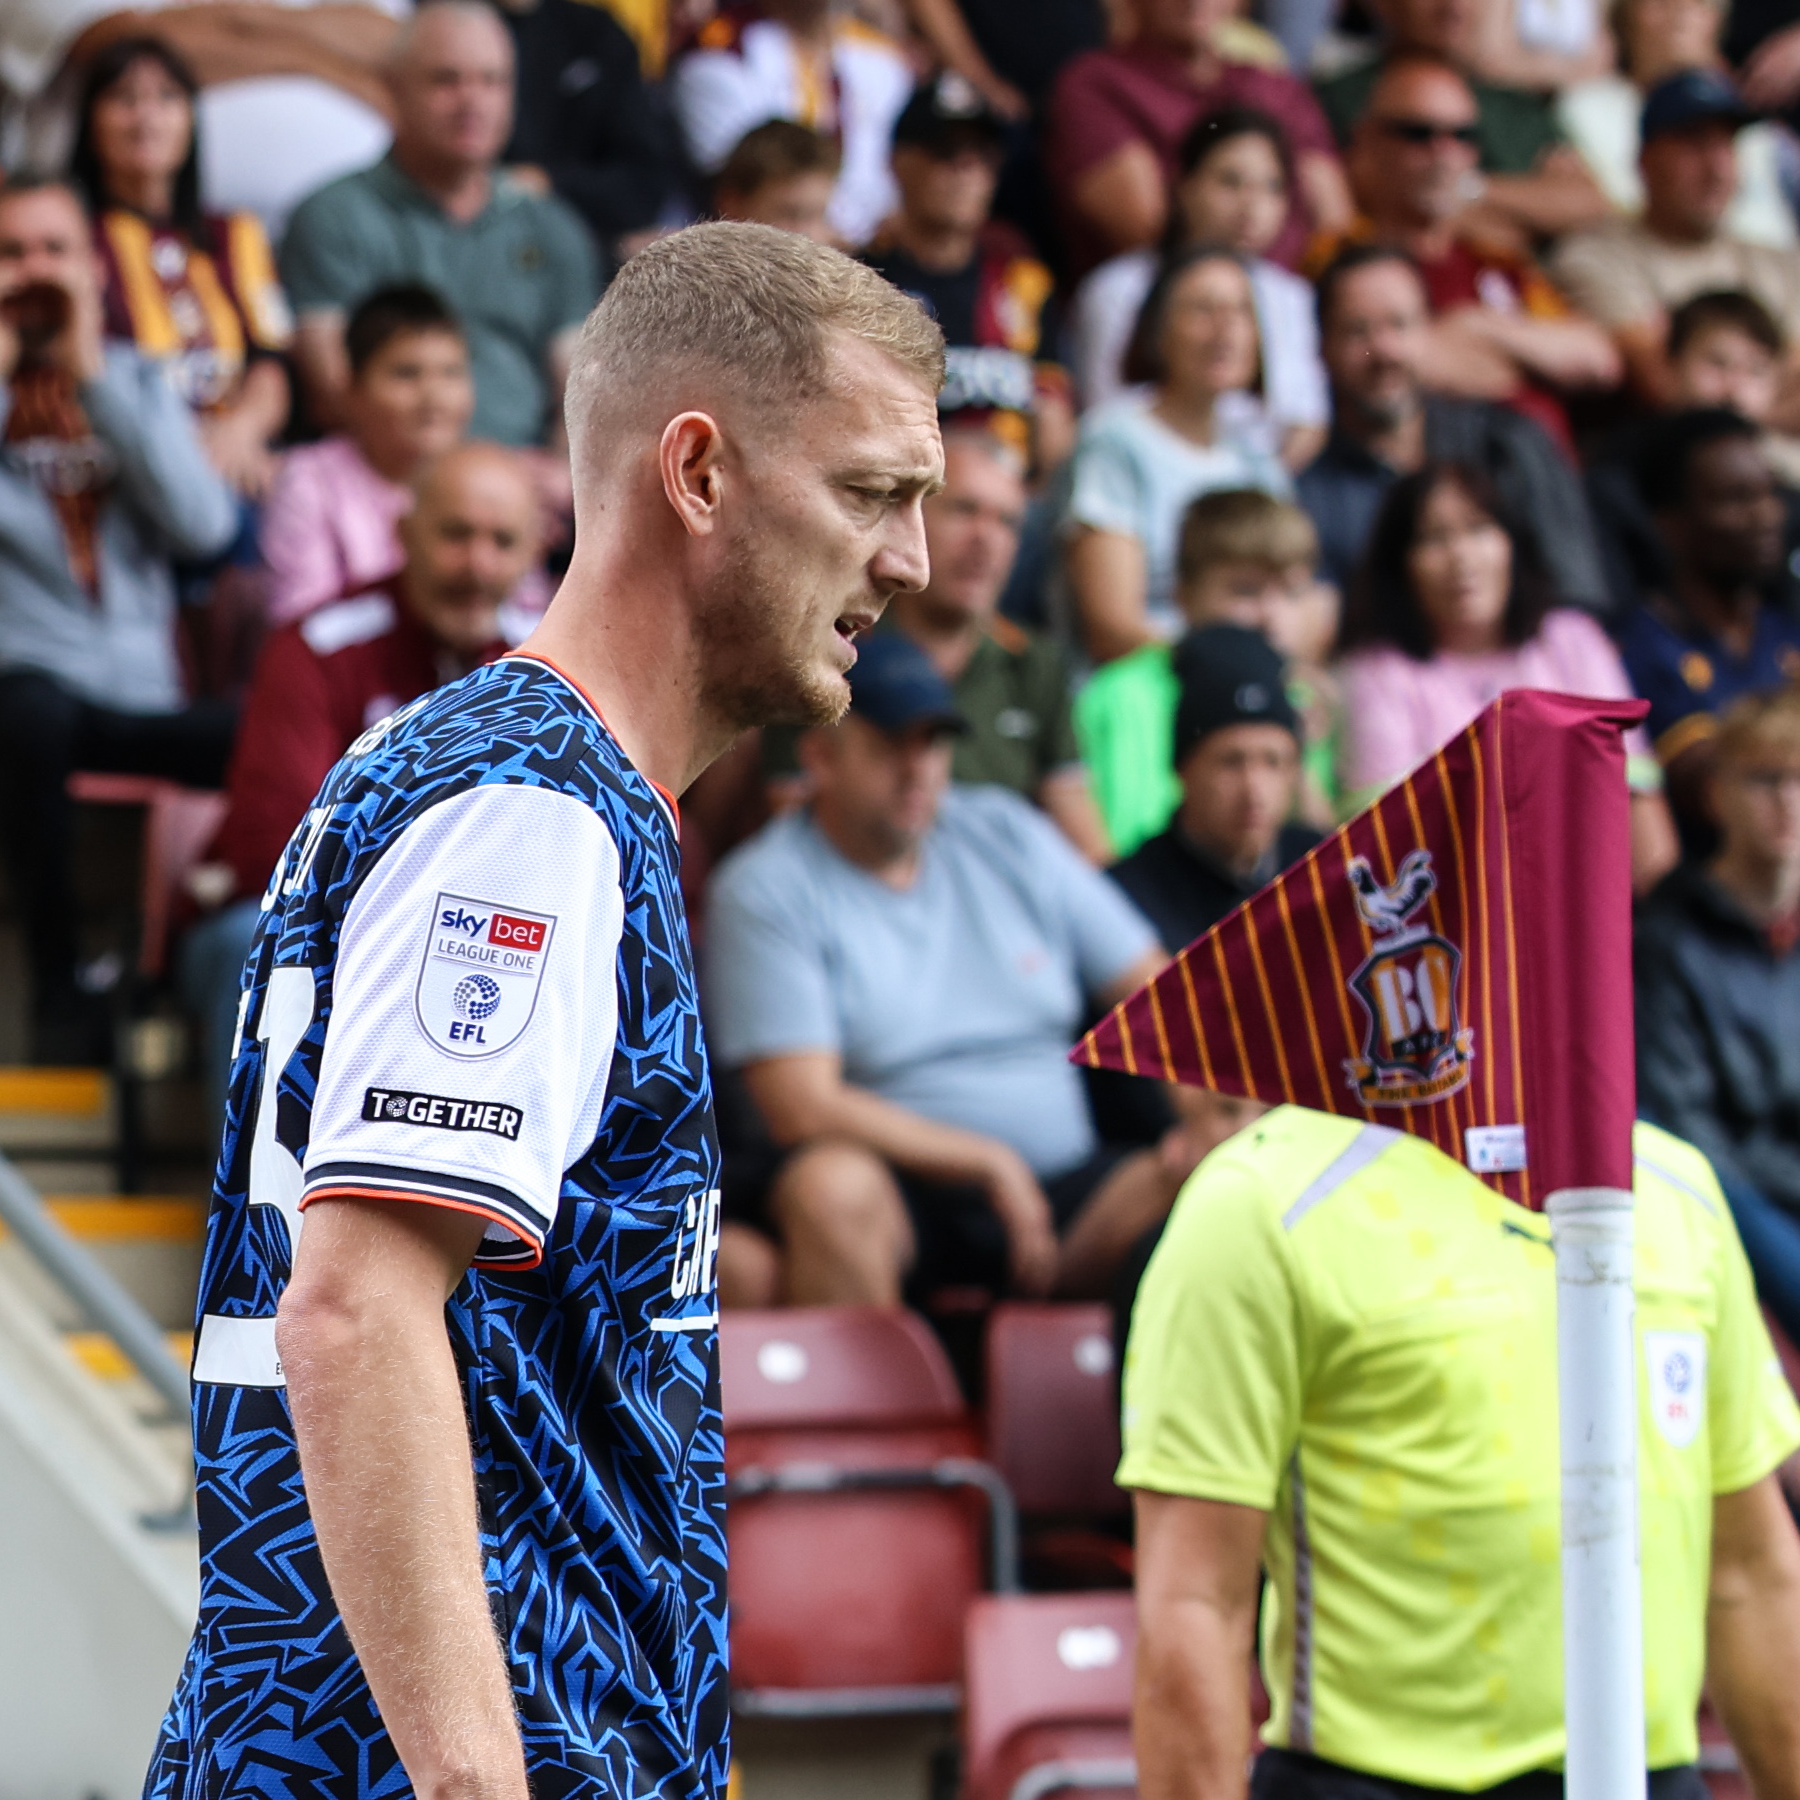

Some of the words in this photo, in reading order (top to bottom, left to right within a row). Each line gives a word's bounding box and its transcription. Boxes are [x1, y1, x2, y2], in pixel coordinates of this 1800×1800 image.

[440, 907, 488, 938] sky
[494, 917, 541, 945] bet
[438, 938, 500, 964] LEAGUE
[503, 952, 536, 970] ONE
[449, 1021, 486, 1044] EFL
